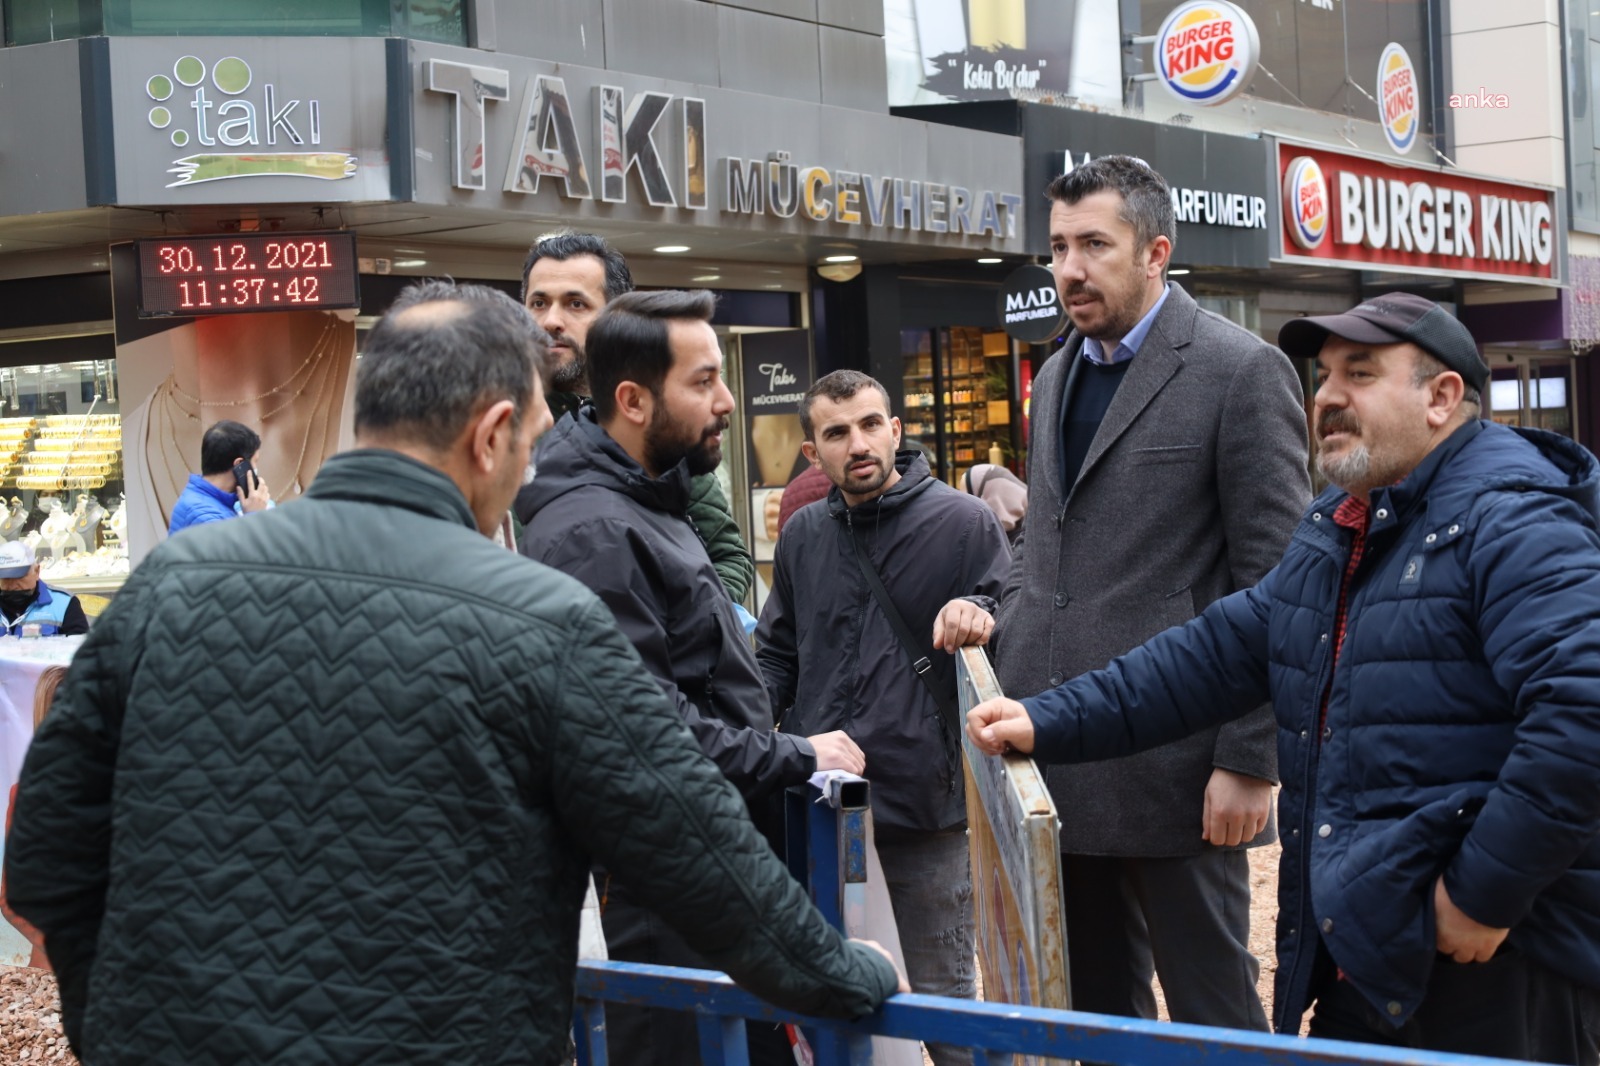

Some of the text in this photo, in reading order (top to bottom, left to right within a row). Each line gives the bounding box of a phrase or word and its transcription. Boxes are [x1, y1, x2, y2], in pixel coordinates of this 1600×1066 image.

[1167, 21, 1232, 54] BURGER
[1168, 37, 1234, 78] KING
[1384, 69, 1411, 98] BURGER
[1386, 86, 1413, 126] KING
[427, 58, 1022, 239] TAKI MÜCEVHERAT
[1170, 187, 1267, 230] ARFUMEUR
[1339, 171, 1551, 266] BURGER KING
[179, 276, 319, 307] 11:37:42
[1005, 286, 1057, 312] MAD
[1005, 306, 1058, 324] PARFUMEUR
